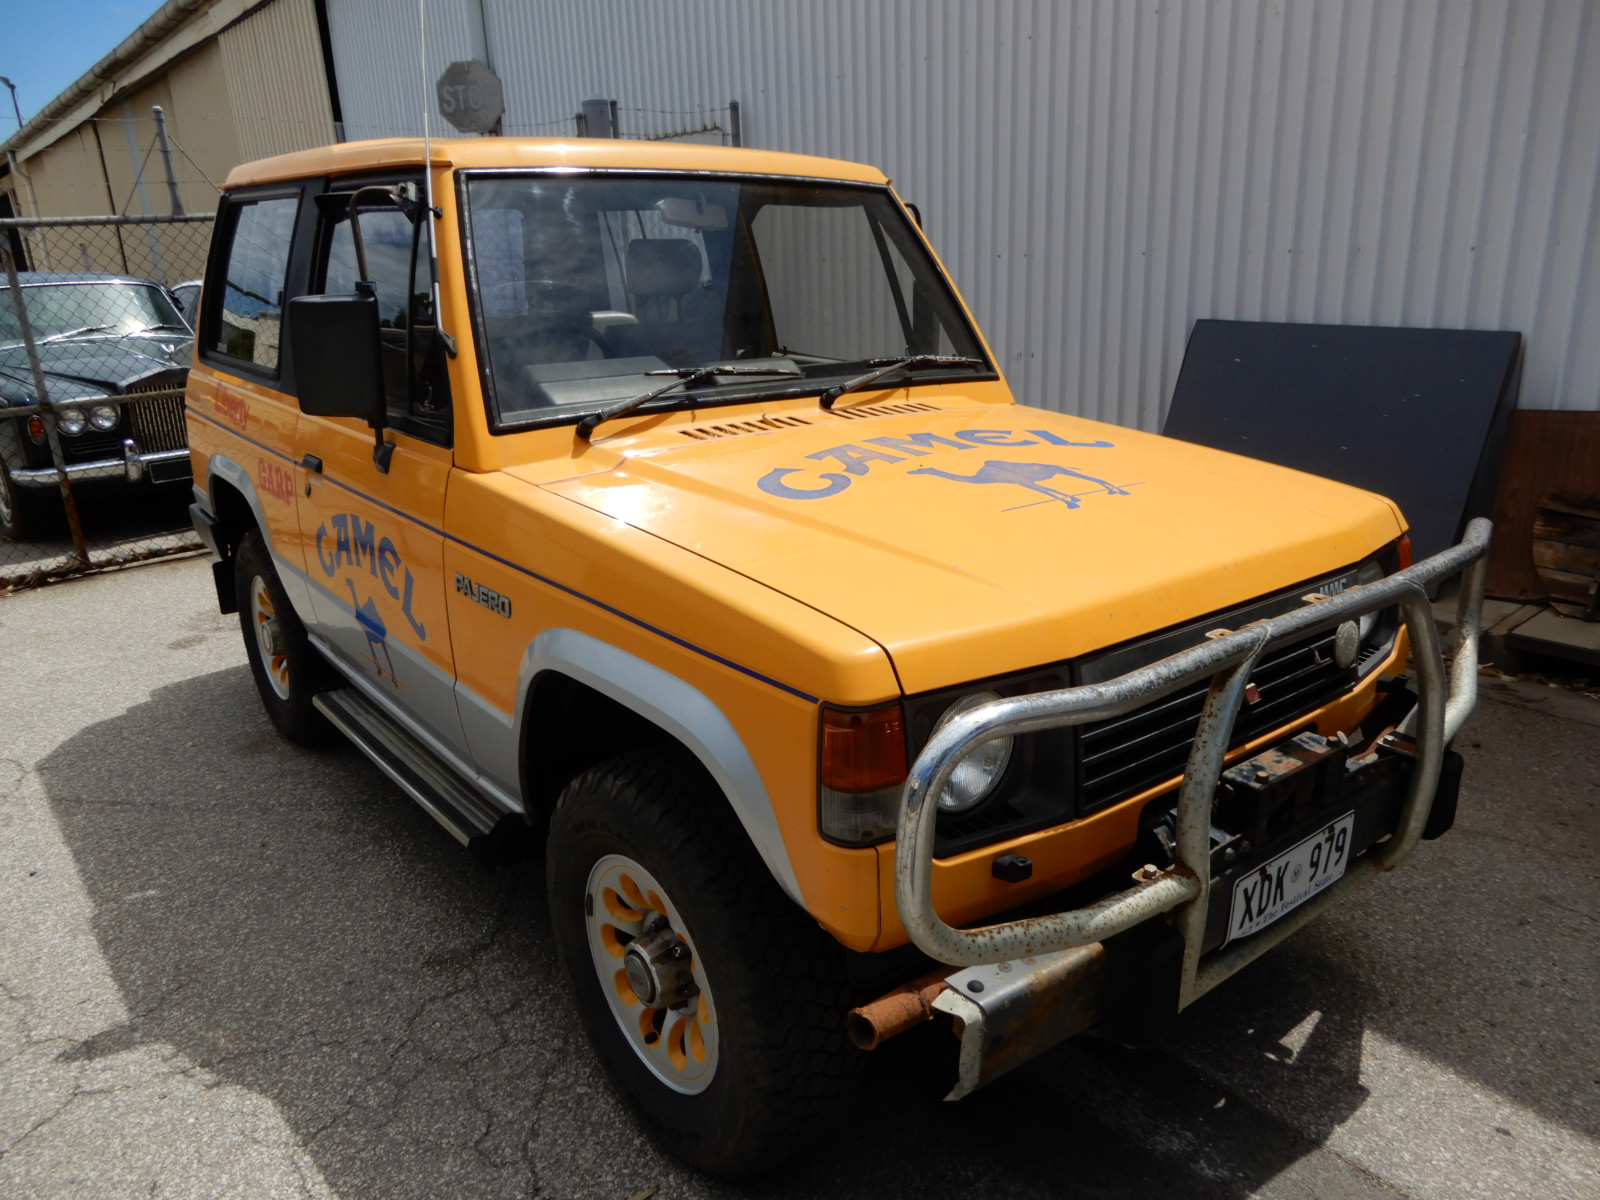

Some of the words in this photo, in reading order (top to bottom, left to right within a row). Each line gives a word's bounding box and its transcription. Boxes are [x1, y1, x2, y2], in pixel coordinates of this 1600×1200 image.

[442, 82, 497, 113] STOP
[757, 429, 1115, 500] CAMEL
[316, 513, 426, 641] CAMEL
[455, 571, 512, 619] PAJERO
[1239, 861, 1290, 930] XDK
[1309, 826, 1348, 883] 979
